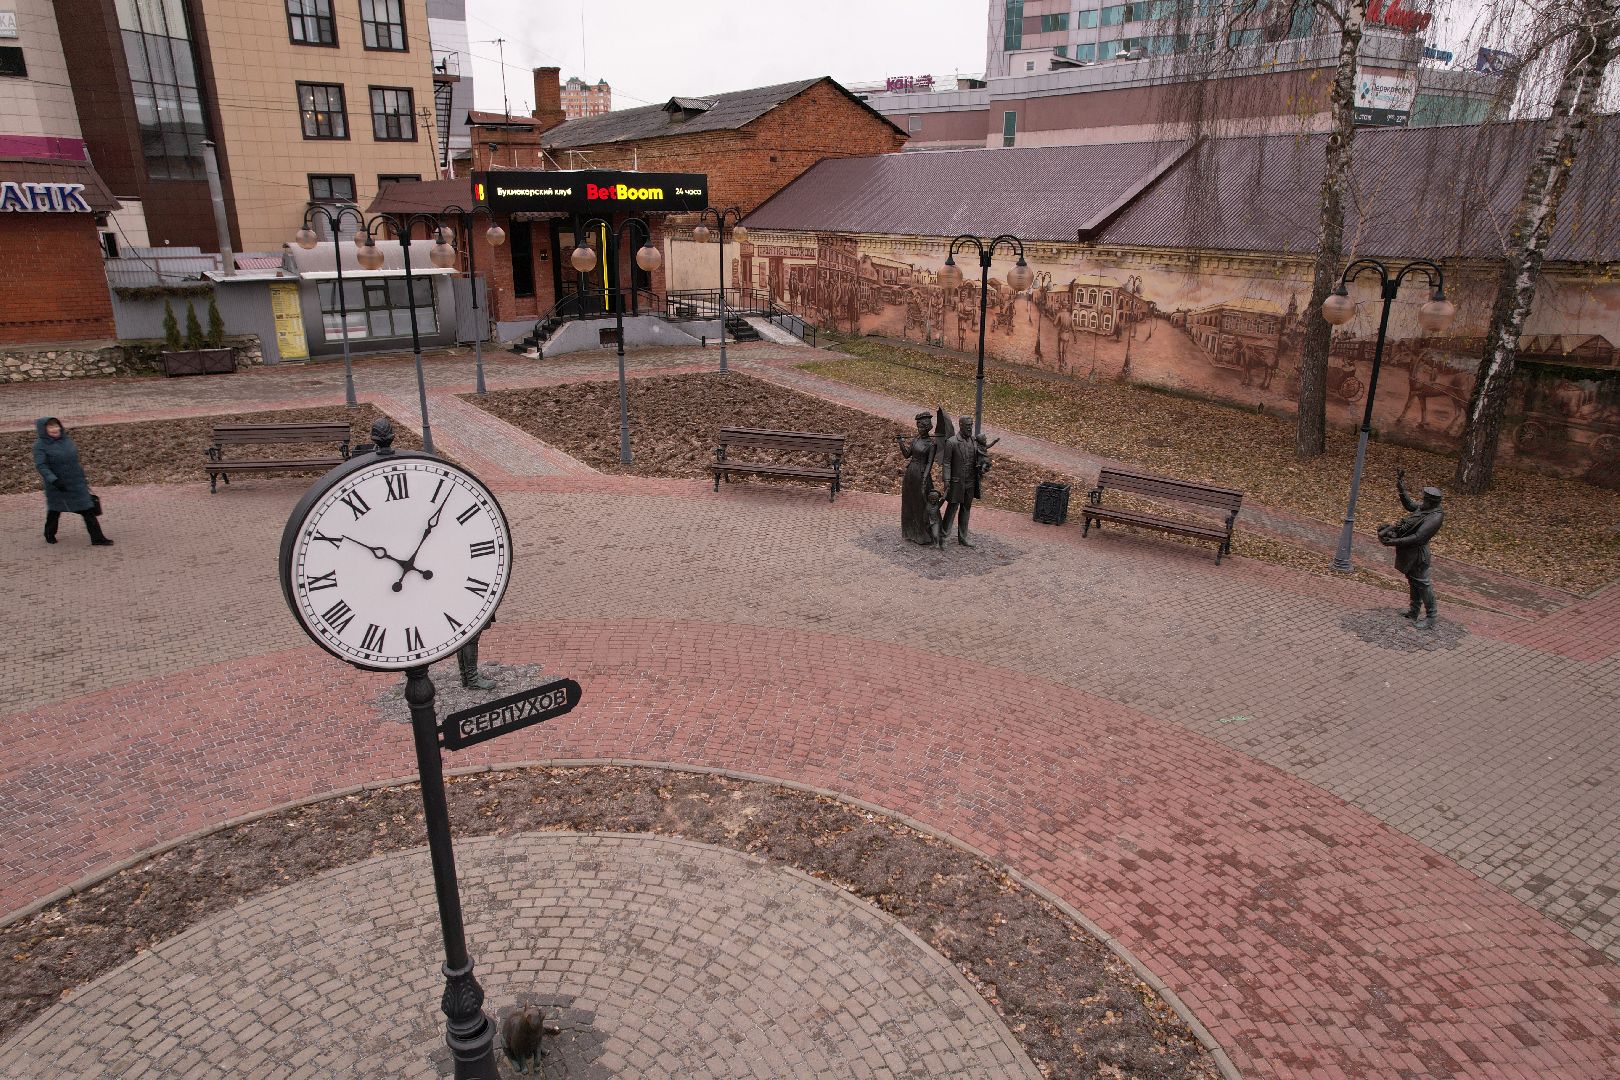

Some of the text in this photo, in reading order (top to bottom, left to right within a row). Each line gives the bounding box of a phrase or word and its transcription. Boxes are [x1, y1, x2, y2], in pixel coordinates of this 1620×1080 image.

[554, 187, 572, 197] клуб
[586, 183, 664, 200] BetBoom
[675, 187, 684, 195] 24
[383, 473, 410, 502] XII
[430, 478, 445, 503] I
[340, 489, 371, 521] XI
[456, 502, 481, 526] II
[313, 529, 343, 549] X
[470, 539, 496, 559] III
[307, 570, 338, 592] IX
[464, 576, 490, 599] IV
[321, 599, 356, 635] VIII
[443, 612, 463, 632] V
[360, 624, 387, 653] VII
[405, 626, 426, 652] VI
[460, 688, 567, 736] СЕРПУХОВ
